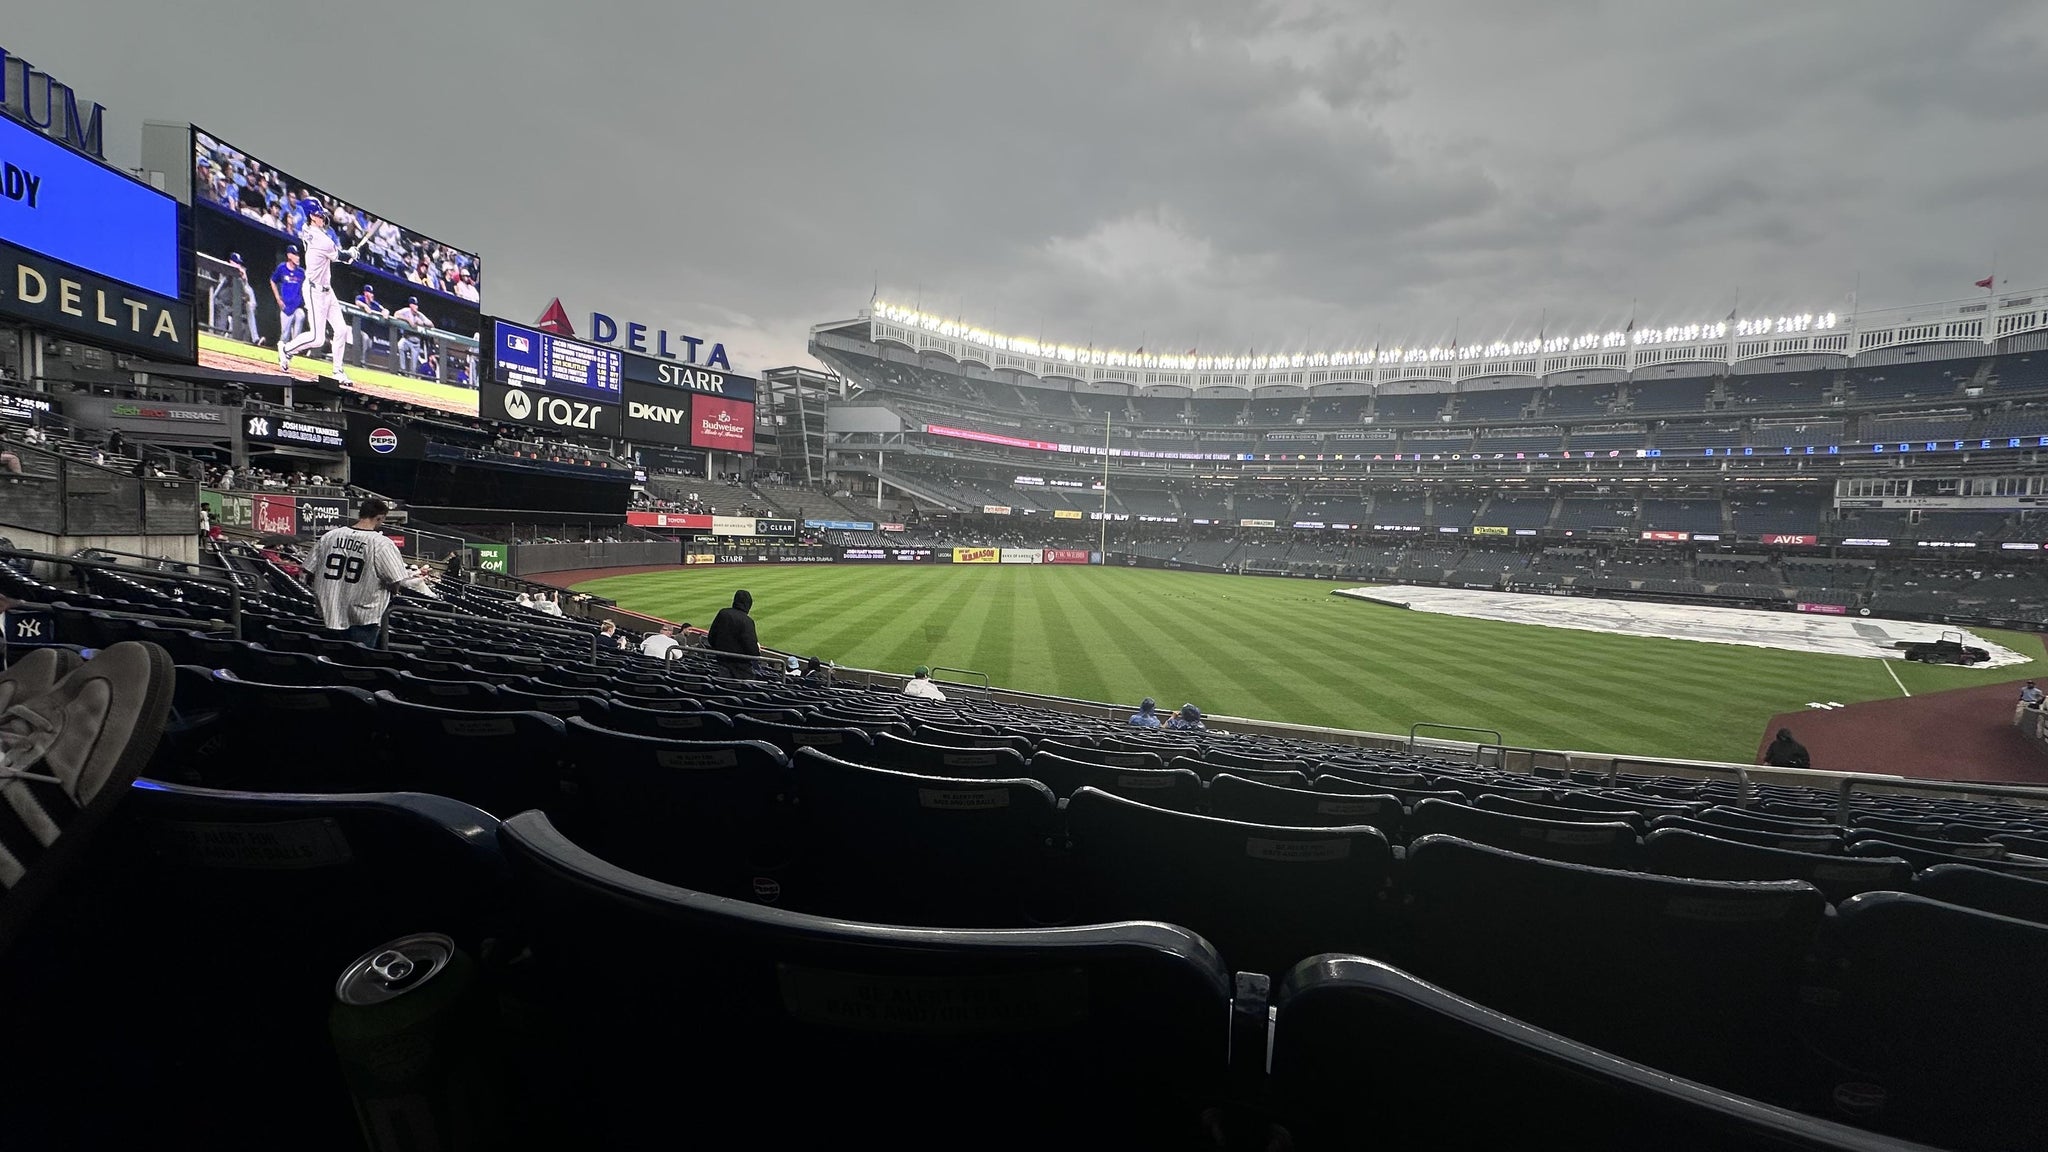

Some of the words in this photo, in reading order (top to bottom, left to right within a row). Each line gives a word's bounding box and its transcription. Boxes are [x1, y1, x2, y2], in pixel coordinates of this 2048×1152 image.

[0, 161, 41, 209] DY
[17, 263, 179, 343] DELTA
[591, 312, 731, 371] DELTA
[657, 363, 724, 394] STARR
[35, 401, 50, 412] PM
[537, 397, 602, 430] razr
[628, 401, 685, 425] DKNY
[168, 410, 220, 421] TERRACE
[282, 421, 298, 431] JOSH
[298, 423, 315, 434] HART
[315, 426, 339, 438] YANKEES
[702, 419, 744, 433] Budweiser
[370, 437, 396, 445] PEPSI
[1073, 445, 1089, 455] RAFFLE
[1705, 447, 1753, 456] BIG
[1783, 445, 1839, 455] TEN
[313, 505, 340, 523] coupa
[332, 537, 367, 554] JUDGE
[1773, 535, 1804, 544] AVIS
[720, 555, 743, 563] STARR
[323, 552, 365, 584] 99
